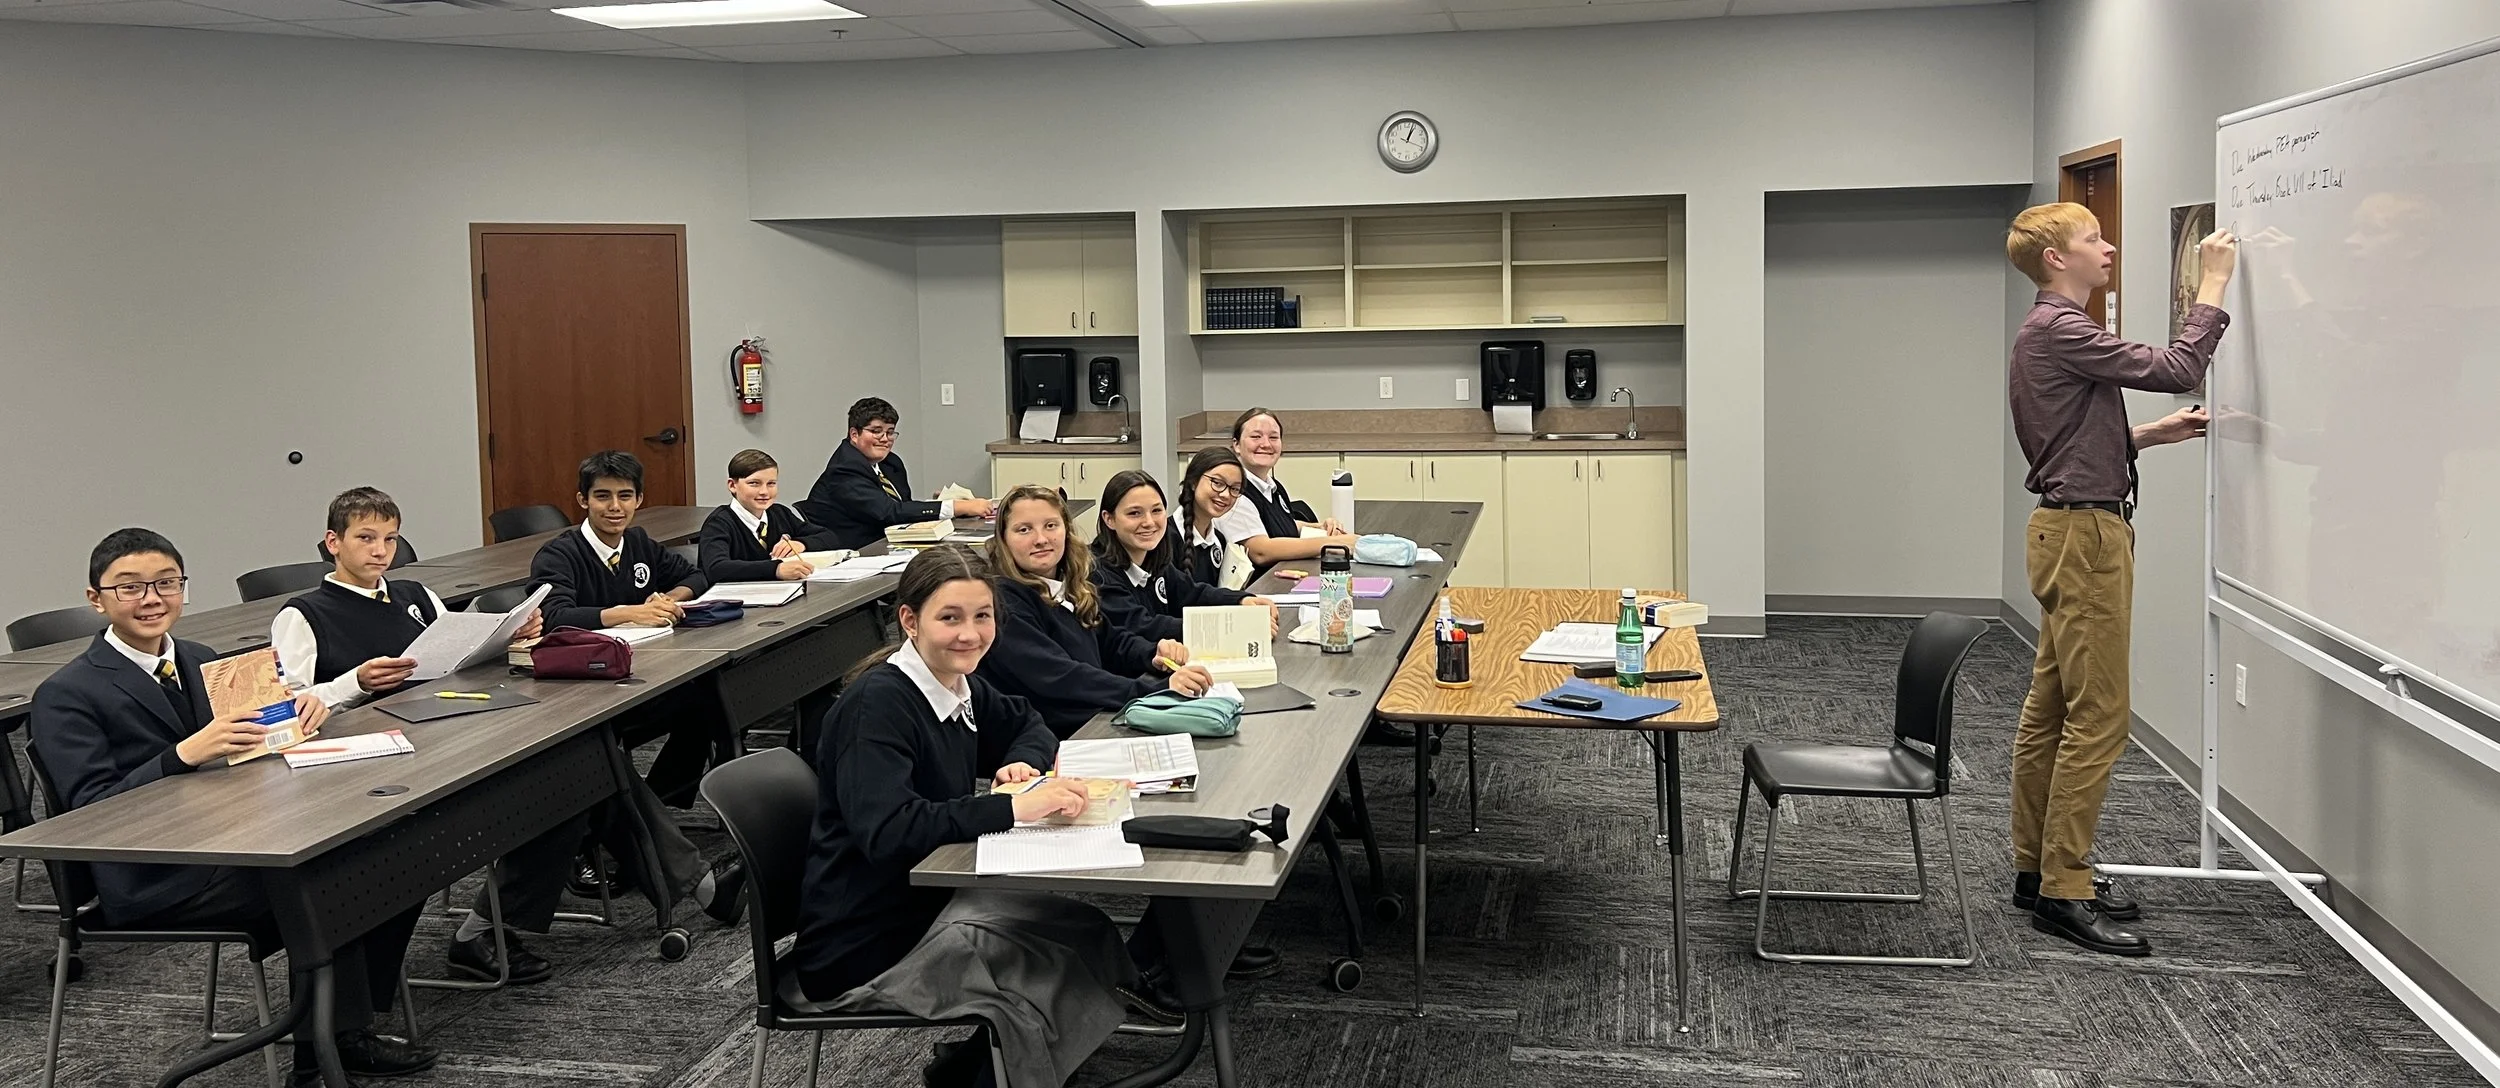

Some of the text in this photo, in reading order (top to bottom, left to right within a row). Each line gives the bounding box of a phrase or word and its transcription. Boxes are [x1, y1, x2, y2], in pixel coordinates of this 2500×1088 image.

[2232, 185, 2243, 208] Due
[2276, 175, 2291, 198] Book
[2307, 170, 2316, 190] of
